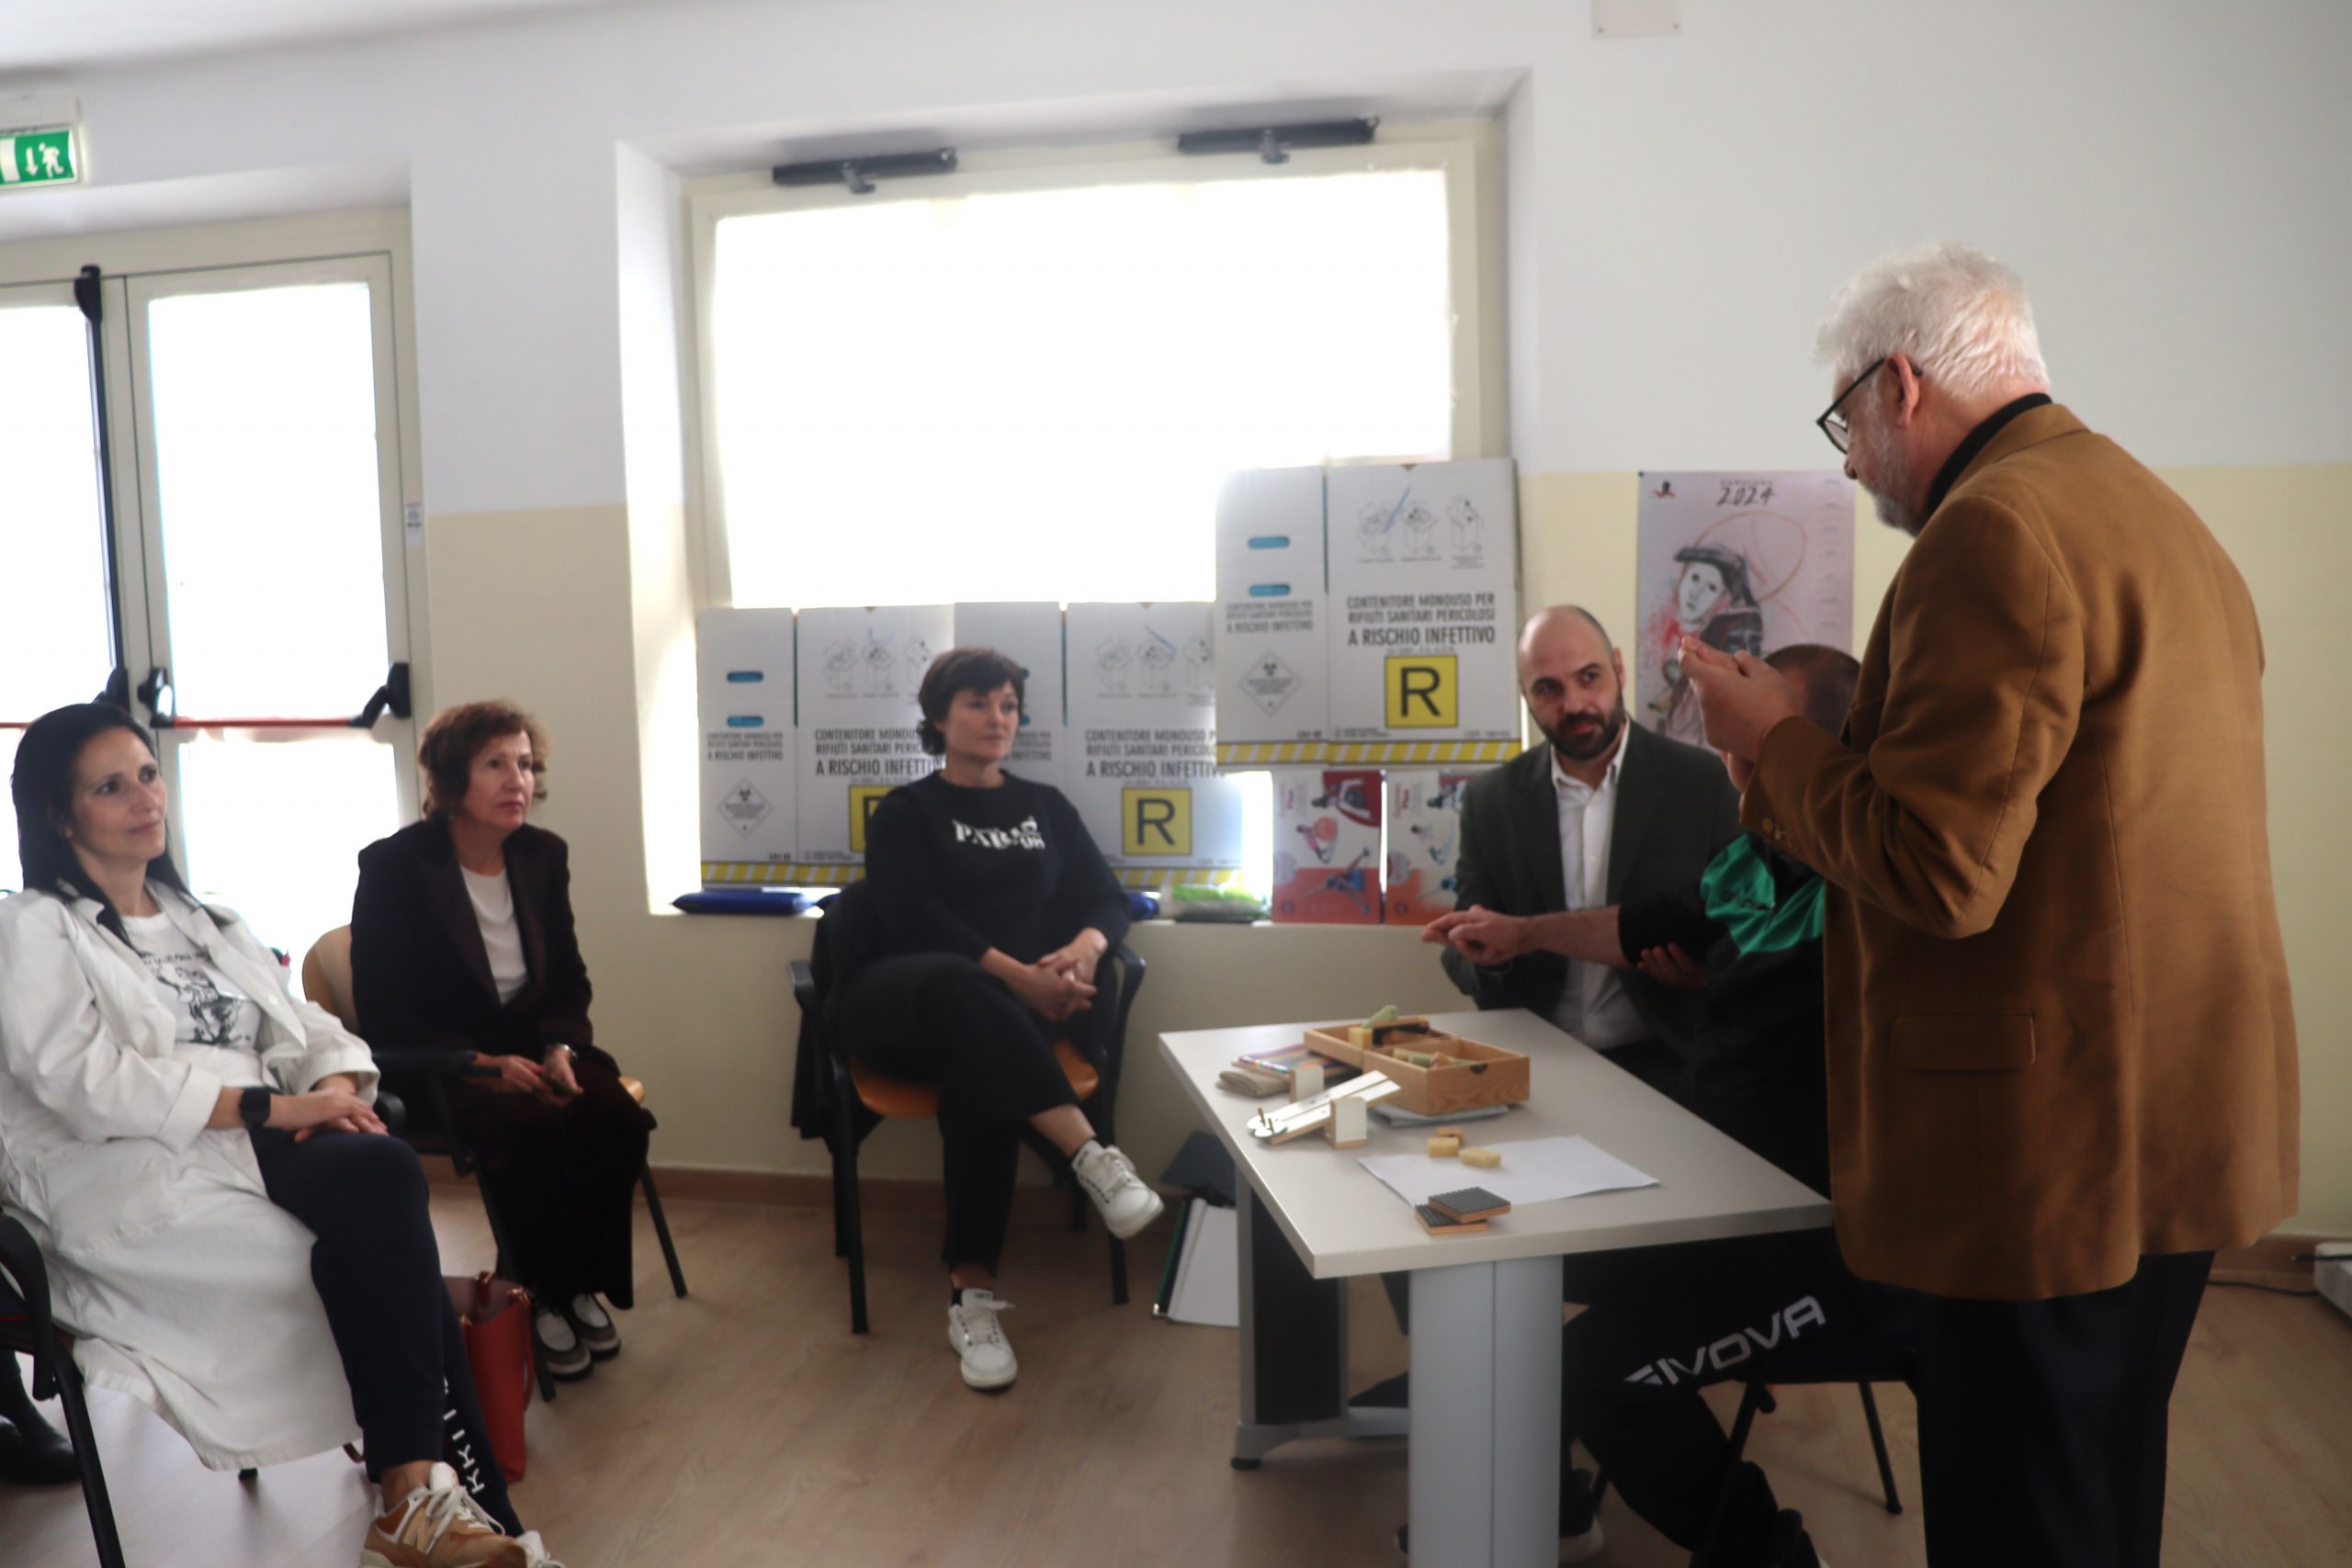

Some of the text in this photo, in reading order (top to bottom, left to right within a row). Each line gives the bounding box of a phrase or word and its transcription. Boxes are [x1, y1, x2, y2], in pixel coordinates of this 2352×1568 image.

[1716, 487, 1777, 507] 2024
[1347, 592, 1495, 608] CONTENITORE MONOUSO PER
[1348, 607, 1495, 624] RIFIUTI SANITARI PERICOLOSI
[1348, 626, 1496, 646] A RISCHIO INFETTIVO
[1400, 666, 1442, 717] R
[815, 728, 875, 740] CONTENITORE
[1085, 728, 1150, 741] CONTENITORE
[816, 742, 848, 755] RIFIUTI
[851, 742, 891, 754] SANITARI
[1125, 743, 1169, 756] SANITARI
[816, 760, 825, 775] A
[829, 759, 880, 775] RISCHIO
[1087, 761, 1096, 777] A
[1101, 761, 1156, 777] RISCHIO
[1137, 797, 1176, 846] R
